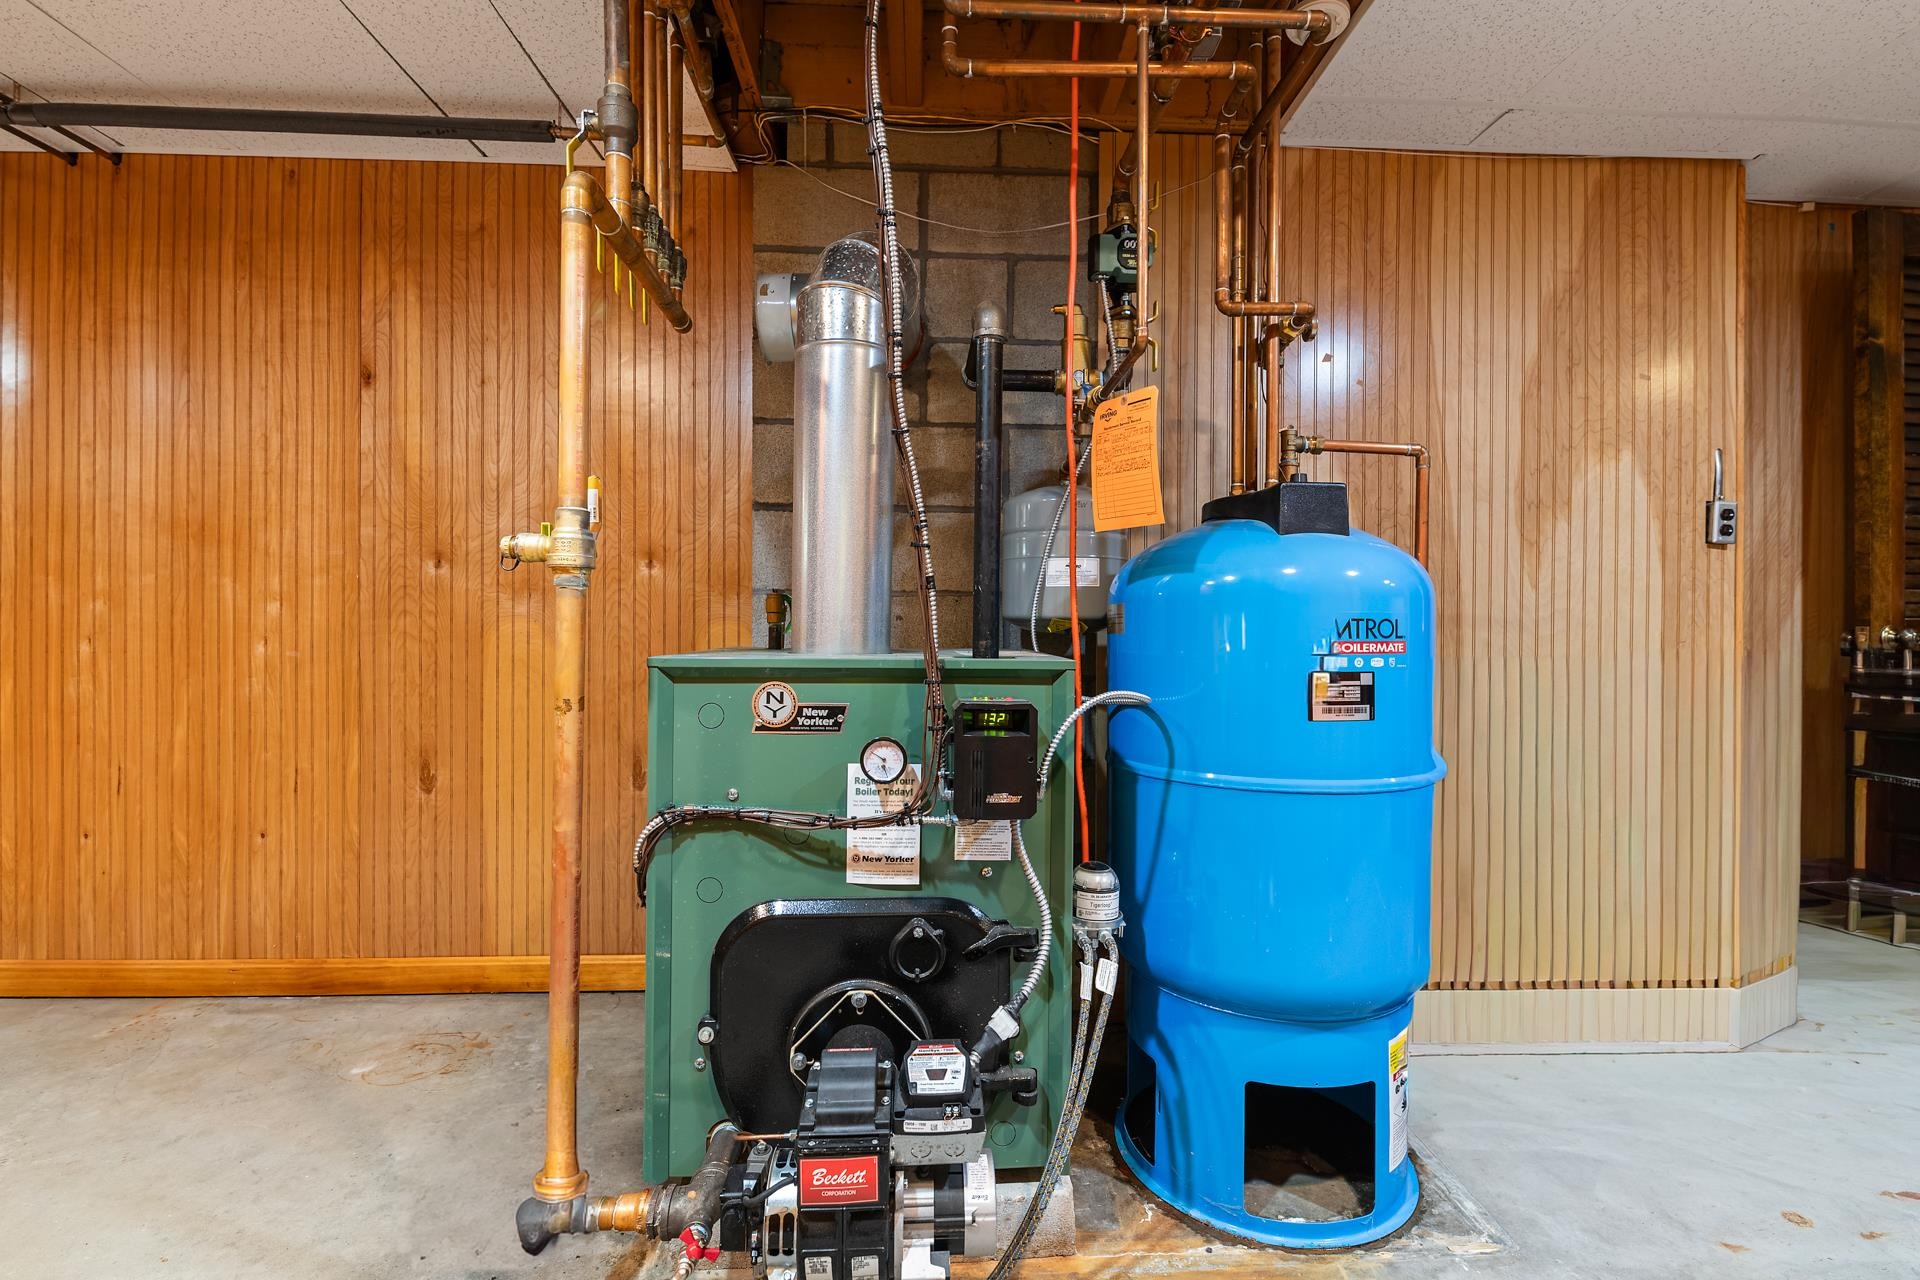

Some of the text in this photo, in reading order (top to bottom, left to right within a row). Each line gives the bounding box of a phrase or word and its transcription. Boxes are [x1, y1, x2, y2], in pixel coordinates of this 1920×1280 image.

[1124, 239, 1138, 249] 00
[802, 707, 829, 716] New
[797, 717, 836, 726] Yorker
[855, 787, 913, 797] Boiler Today!
[885, 855, 914, 863] Yorker
[812, 1168, 867, 1186] Beckett
